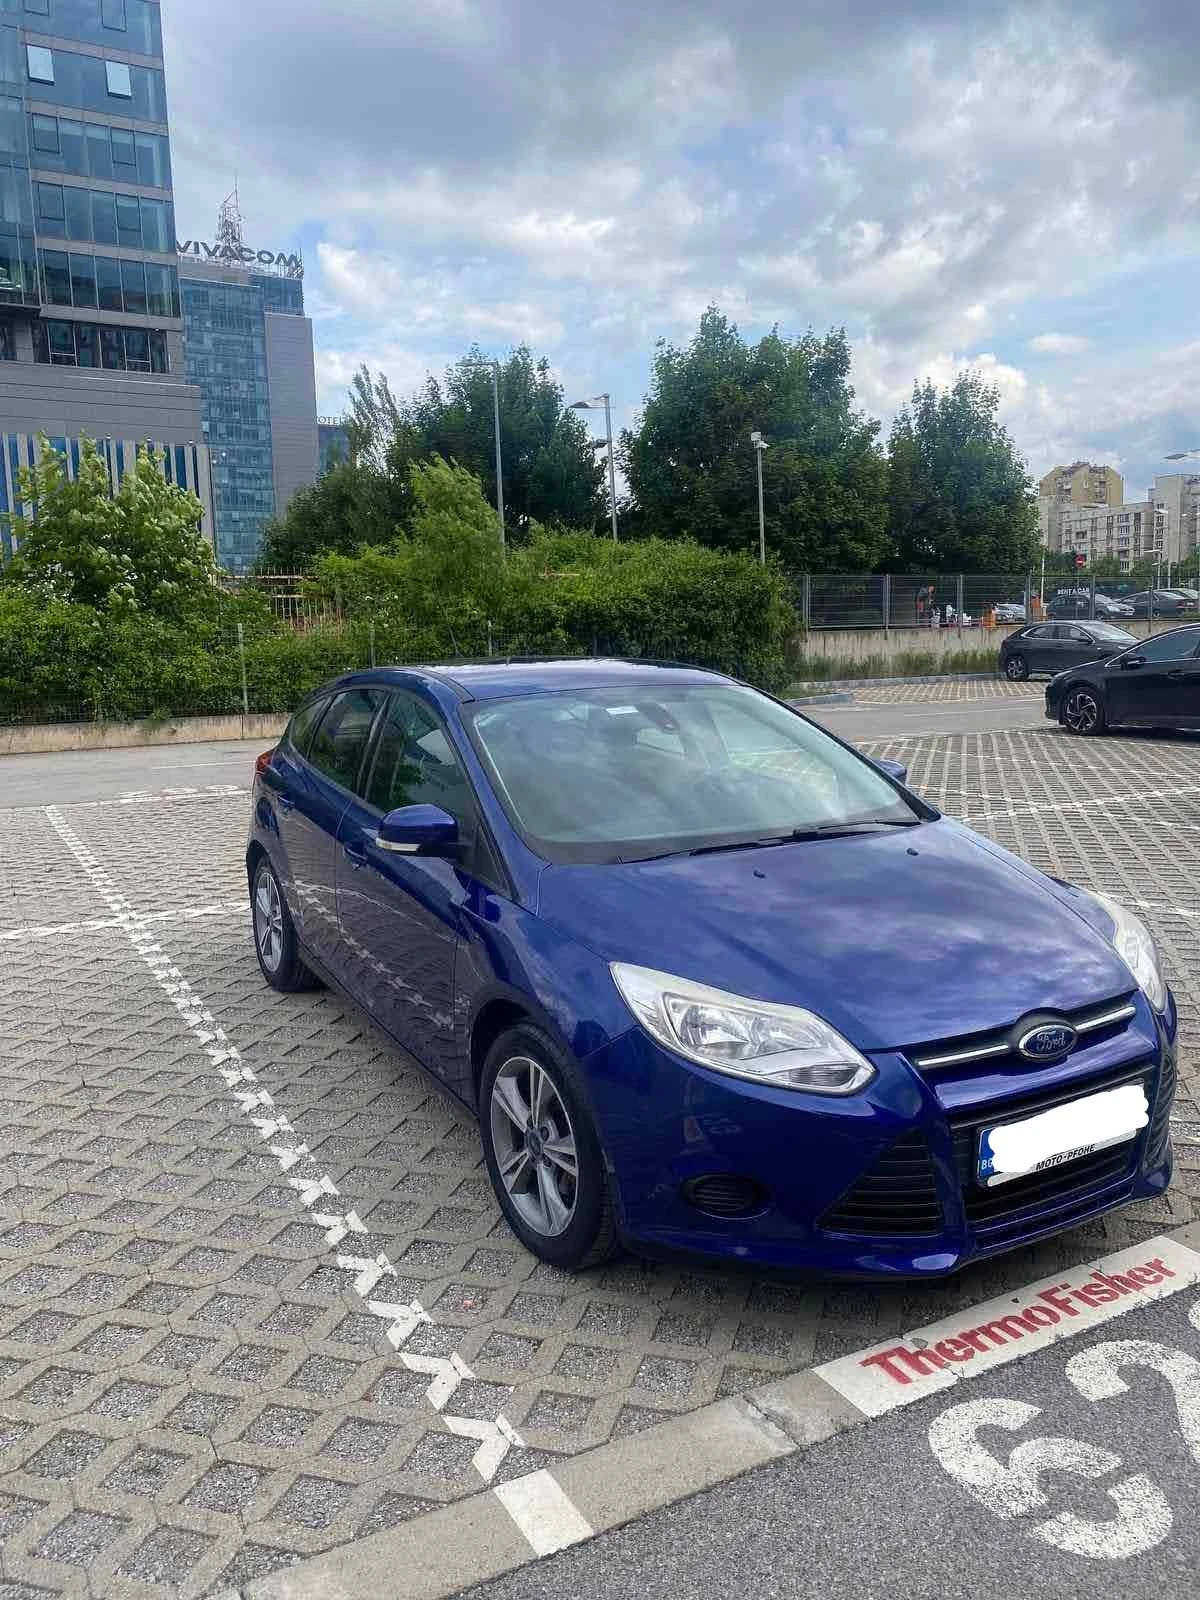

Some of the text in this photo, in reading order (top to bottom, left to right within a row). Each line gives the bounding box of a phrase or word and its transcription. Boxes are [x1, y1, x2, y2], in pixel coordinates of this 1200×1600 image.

[176, 241, 301, 267] VIVACOM
[1035, 1030, 1066, 1051] Ford
[981, 1158, 994, 1171] BG
[858, 1255, 1176, 1386] ThermoFisher
[927, 1300, 1200, 1560] 62
